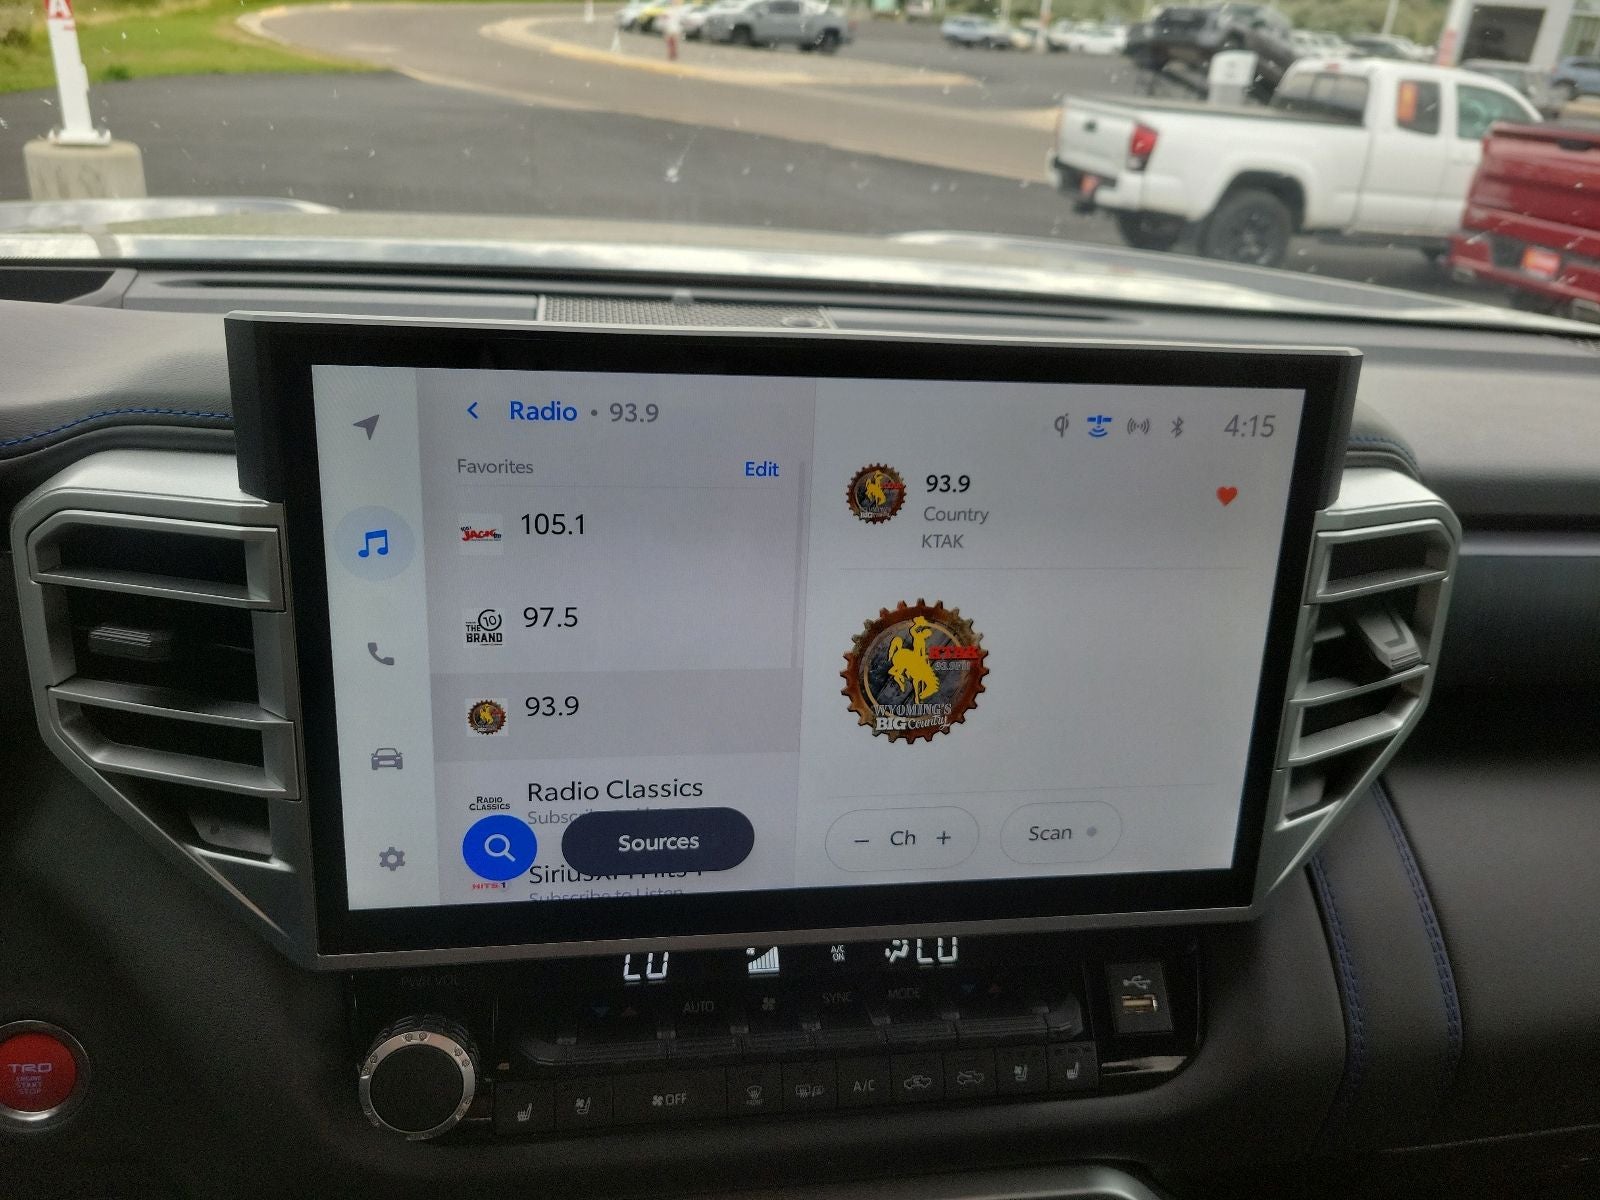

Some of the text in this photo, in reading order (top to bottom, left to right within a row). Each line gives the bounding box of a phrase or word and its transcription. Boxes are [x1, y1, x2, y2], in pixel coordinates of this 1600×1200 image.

[509, 400, 660, 422] Radio 93.9
[1224, 414, 1277, 438] 4:15
[457, 459, 534, 475] Favorites
[744, 461, 780, 477] Edit
[925, 474, 971, 493] 93.9
[923, 506, 990, 525] Country
[520, 513, 586, 536] 105.1
[921, 533, 964, 550] KTAK
[482, 615, 497, 627] 10
[522, 606, 579, 628] 97.5
[465, 624, 481, 632] THE
[466, 632, 503, 643] BRAND
[524, 695, 580, 717] 93.9
[873, 703, 952, 717] WYOMING'S
[875, 714, 952, 732] BIG Country
[527, 777, 704, 803] Radio Classics
[469, 803, 511, 811] CLASSICS
[476, 796, 503, 804] RADIO
[889, 829, 917, 847] Ch
[1028, 825, 1073, 842] Scan
[617, 832, 700, 853] Sources
[830, 944, 845, 953] A/C
[832, 952, 846, 962] ON
[682, 1000, 715, 1014] AUTO
[7, 1063, 52, 1073] TRD
[853, 1078, 876, 1093] A/C
[665, 1091, 687, 1106] OFF
